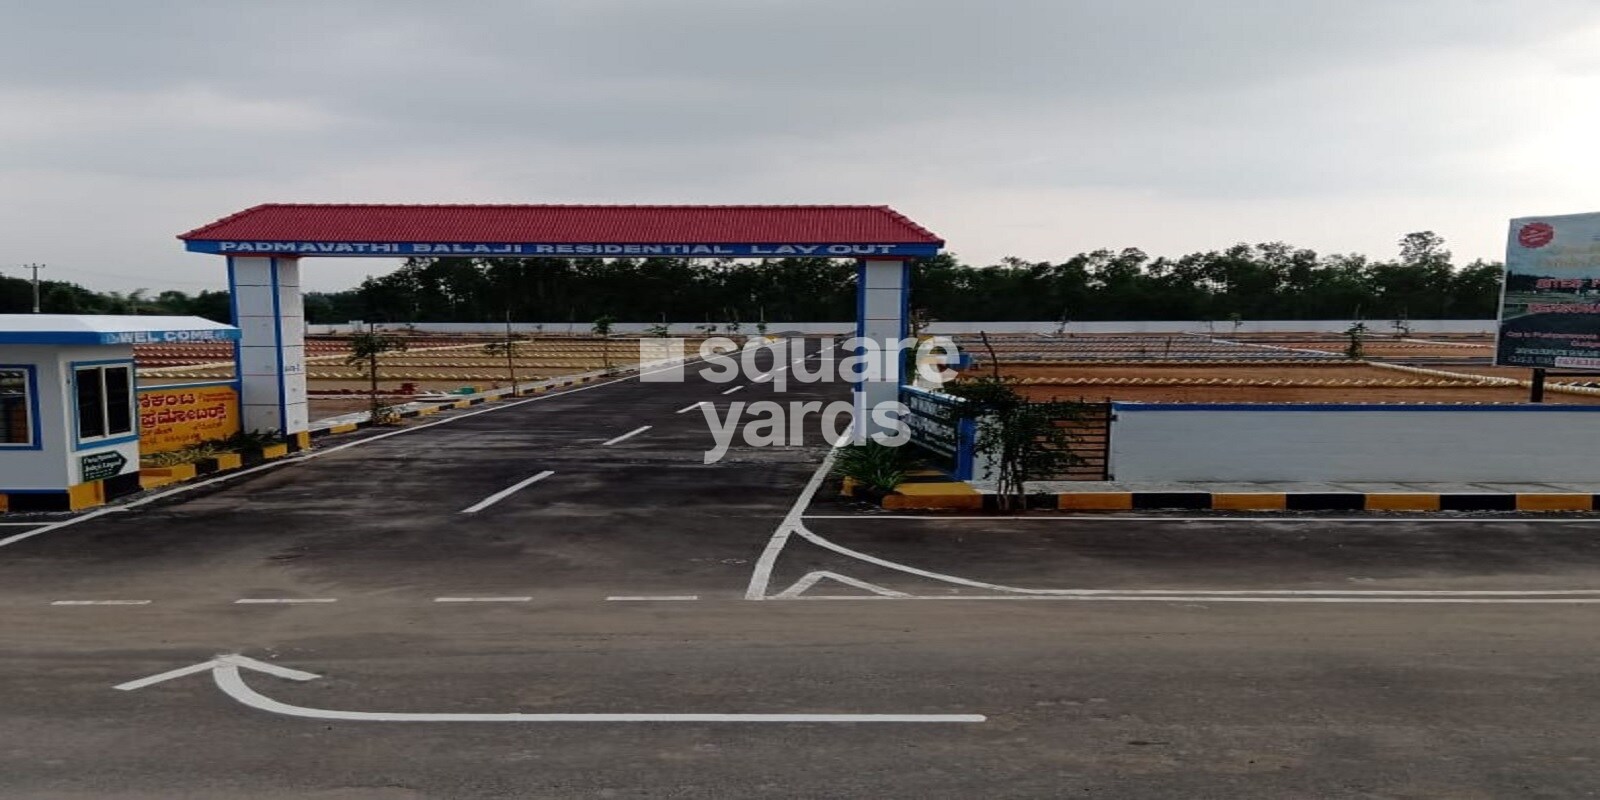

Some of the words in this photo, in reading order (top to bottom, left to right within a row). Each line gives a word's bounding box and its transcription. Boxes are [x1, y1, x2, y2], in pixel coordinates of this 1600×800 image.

[220, 241, 401, 252] PADMAVATHI
[412, 243, 523, 253] BALAJI
[535, 244, 734, 254] RESIDENTIAL
[750, 245, 820, 254] LAY
[826, 245, 897, 254] OUT
